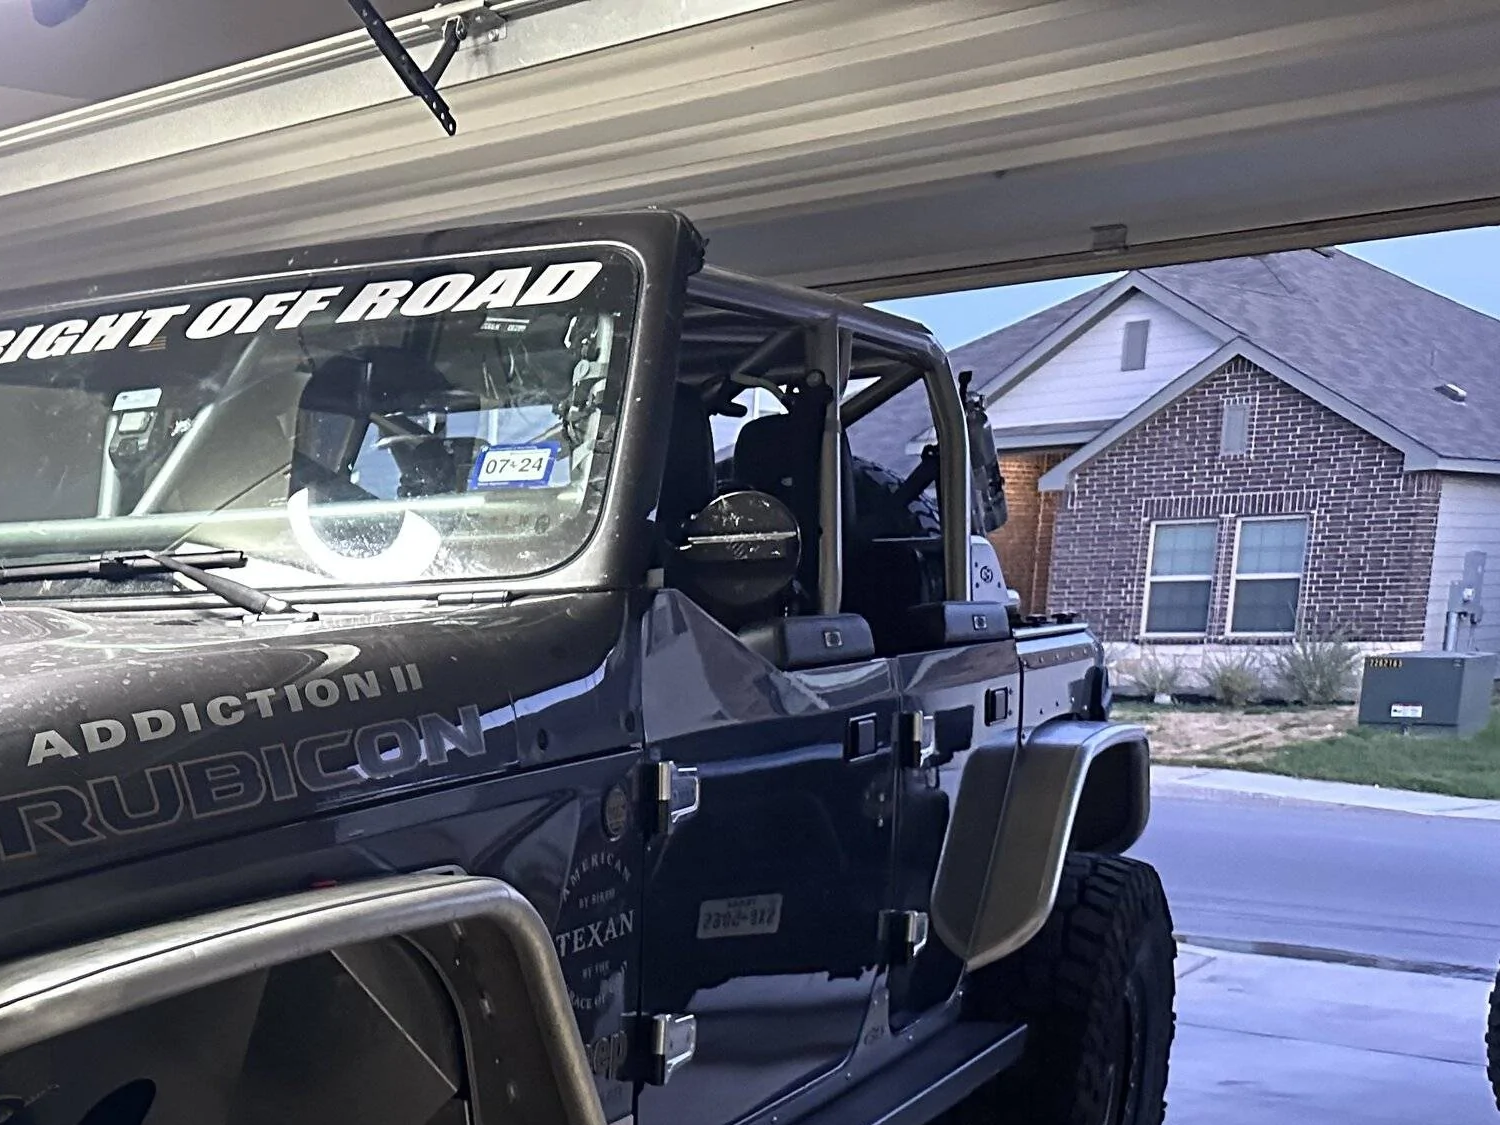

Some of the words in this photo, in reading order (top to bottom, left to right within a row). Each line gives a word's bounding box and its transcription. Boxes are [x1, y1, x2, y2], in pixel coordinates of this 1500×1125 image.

[183, 284, 342, 339] OFF
[335, 261, 606, 325] ROAD
[485, 459, 511, 475] 07
[518, 457, 544, 473] 24
[27, 669, 384, 767] ADDICTION
[390, 663, 424, 691] II
[562, 852, 632, 903] AMERICAN
[555, 910, 634, 958] TEXAN
